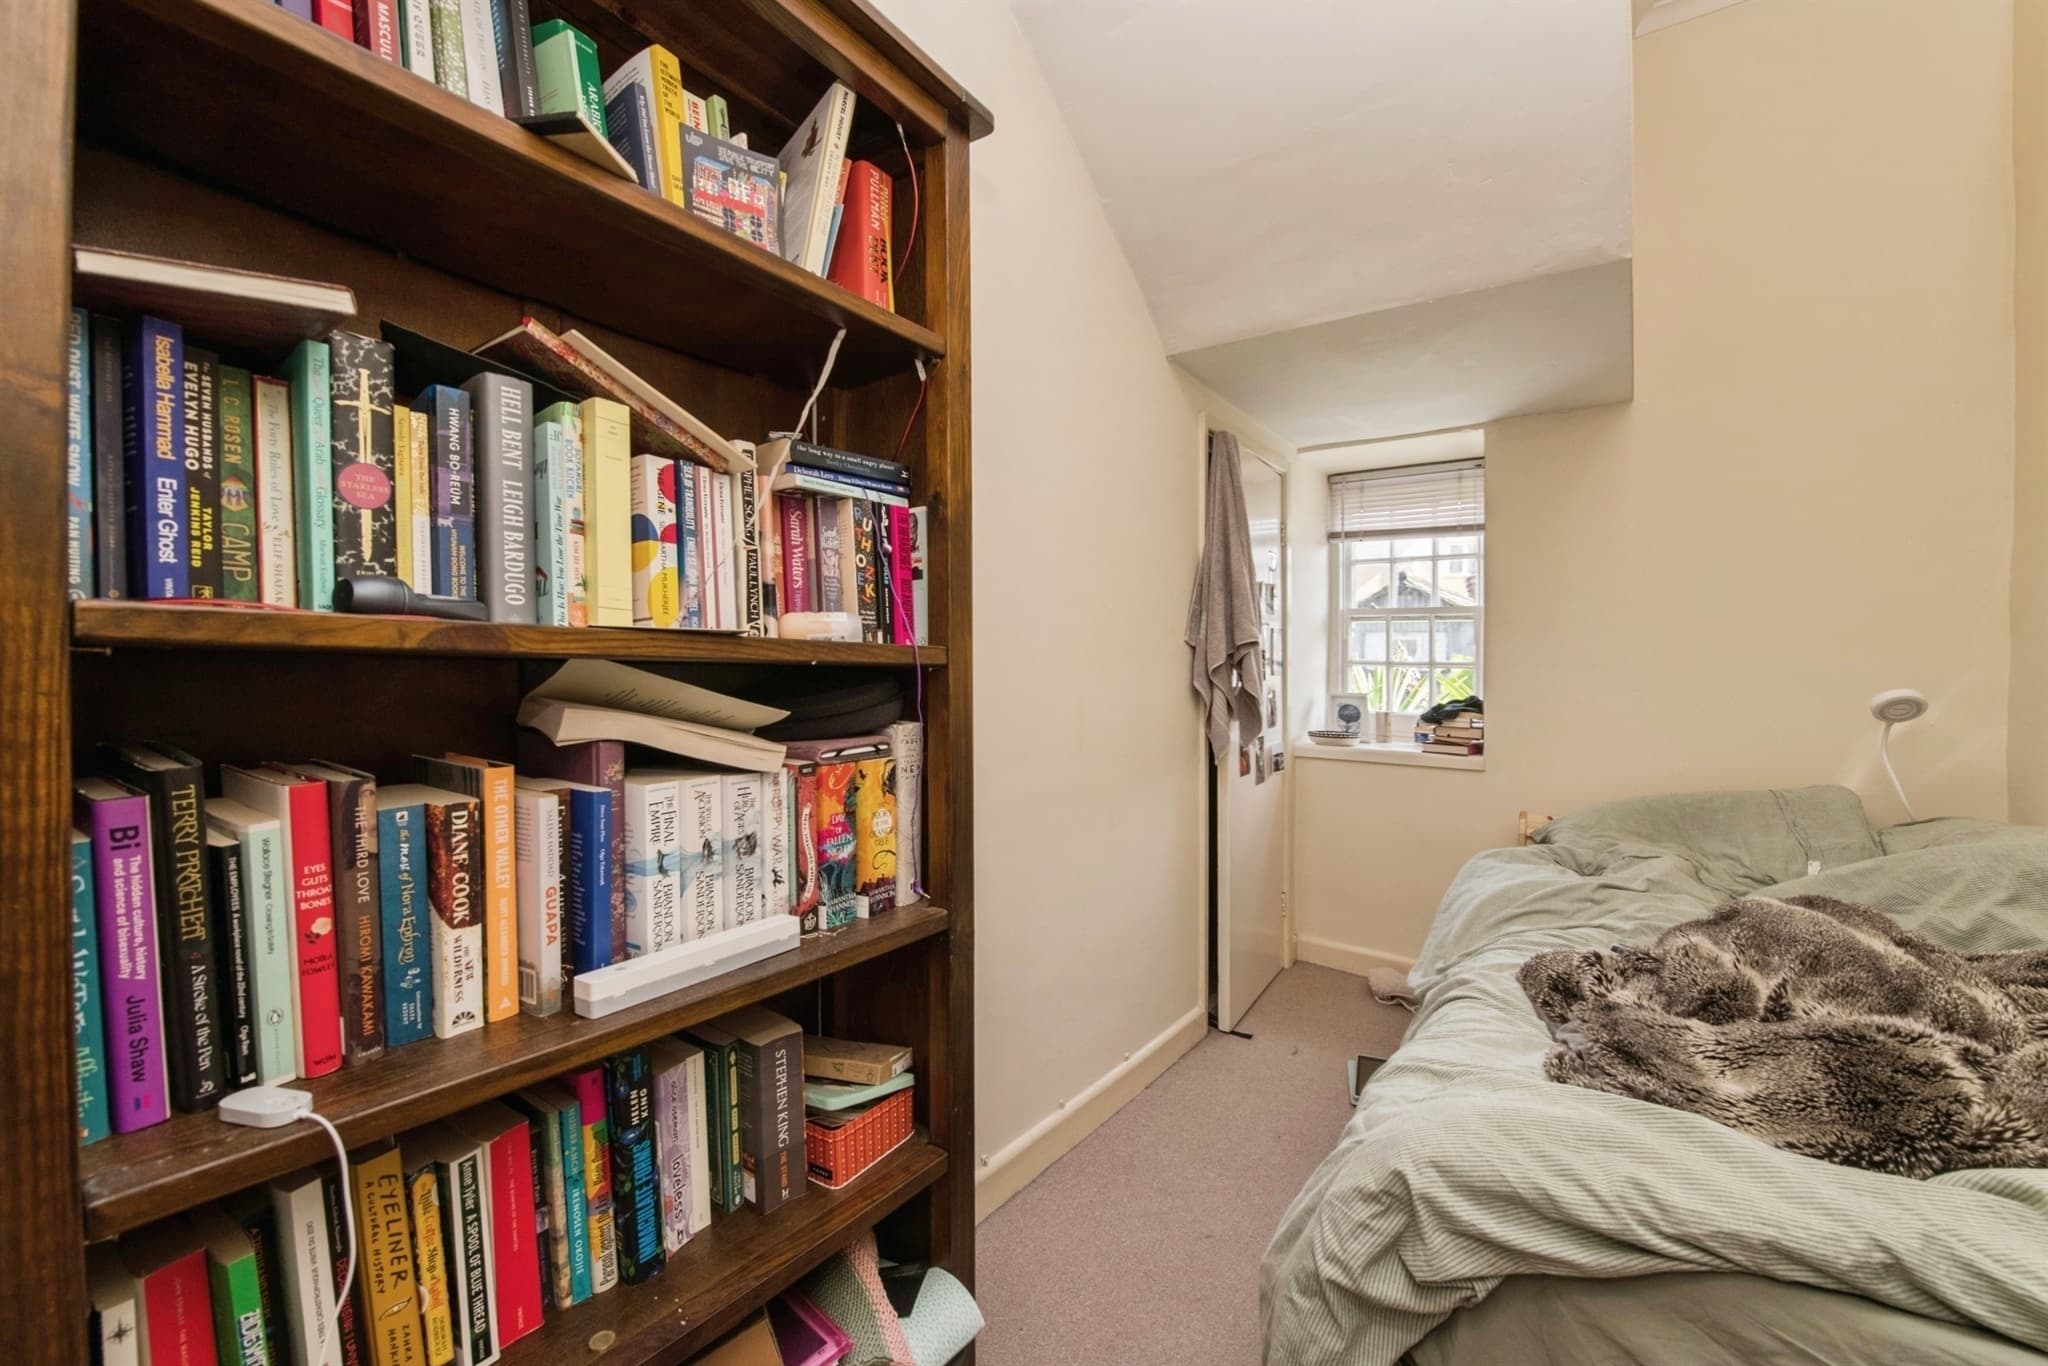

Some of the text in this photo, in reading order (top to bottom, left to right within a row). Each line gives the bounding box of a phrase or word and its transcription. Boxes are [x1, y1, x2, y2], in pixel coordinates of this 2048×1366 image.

[840, 90, 850, 115] MARCEL
[870, 169, 880, 230] PULLMAN
[880, 238, 888, 284] BOOK
[155, 335, 176, 461] Isabella Hammad
[183, 361, 200, 471] EVELYN HUGO
[267, 421, 281, 449] Forty
[312, 357, 328, 530] The Queer Arab Glossary
[500, 386, 523, 471] HELL BENT
[269, 450, 282, 479] Rules
[271, 481, 283, 492] of
[807, 446, 822, 456] long
[822, 450, 833, 459] way
[862, 458, 878, 469] angry
[878, 462, 895, 471] planet
[157, 477, 178, 563] Enter Ghost
[189, 487, 202, 568] JENKINS REID
[202, 507, 213, 550] TAYLOR
[271, 495, 284, 522] Love
[744, 504, 756, 537] SONG
[69, 516, 82, 584] PAN HUITING
[221, 522, 250, 582] CAMP
[272, 536, 285, 605] ELIF SHAFAK
[502, 479, 526, 606] LEIGH BARDUGO
[789, 511, 805, 589] Sarah Waters
[660, 572, 669, 616] MUKHERJEE
[749, 552, 760, 618] PAUL LYNCH
[647, 801, 664, 846] EMPIRE
[662, 795, 678, 846] THE FINAL
[693, 790, 707, 840] ASCENSION
[733, 801, 747, 836] OF AGES
[736, 786, 750, 813] HERO
[748, 797, 756, 808] THE
[108, 825, 141, 852] Bi
[354, 805, 370, 903] THE THIRD LOVE
[493, 777, 511, 889] THE OTHER VALLEY
[546, 809, 556, 878] SALEEM HADDAD
[705, 824, 712, 833] OF
[772, 834, 784, 865] WAR
[170, 784, 206, 942] TERRY PRATCHETT
[228, 856, 238, 871] THE
[228, 871, 240, 911] EMPLOYEES
[260, 838, 273, 901] Wallace Stegner
[301, 877, 329, 886] GUTS
[303, 865, 326, 875] EYES
[450, 810, 471, 926] DIANE COOK
[113, 858, 132, 980] and science of bisexuality
[128, 855, 147, 980] The hidden culture, history
[295, 889, 332, 900] THROAT
[299, 899, 332, 911] BONES
[396, 829, 421, 966] the most of Nora Ephron
[544, 885, 558, 947] GUAPA
[652, 879, 664, 953] SANDERSON
[662, 883, 674, 943] BRANDON
[695, 871, 706, 939] SANDERSON
[705, 874, 715, 930] BRANDON
[735, 863, 745, 927] SANDERSON
[744, 867, 755, 922] BRANDON
[230, 919, 243, 948] workplace
[232, 949, 244, 965] novel
[233, 965, 244, 973] of
[234, 973, 245, 982] the
[359, 915, 375, 1036] HIROMI KAWAKAMI
[452, 934, 465, 1004] WILDERNESS
[464, 960, 474, 982] NEW
[190, 964, 213, 1071] A Stroke of the Pen
[234, 997, 247, 1019] century
[125, 995, 153, 1083] Julia Shaw
[629, 1089, 640, 1125] HELEN
[639, 1087, 648, 1118] KING
[670, 1081, 680, 1144] alice oseman
[774, 1048, 789, 1148] STEPHEN KING
[568, 1108, 579, 1175] NUDIBRANCH
[461, 1161, 475, 1210] Anne Tyler
[631, 1139, 658, 1263] IMMACULATE FORMS
[671, 1153, 686, 1221] loveless
[780, 1166, 789, 1188] STAND
[367, 1193, 379, 1244] CULTURAL
[381, 1174, 408, 1288] EYELINER
[571, 1188, 585, 1275] IRENOSEN OKOJIE
[372, 1249, 385, 1295] HISTORY
[466, 1214, 486, 1333] A SPOOL OF BLUE THREAD
[402, 1324, 411, 1362] ZAHRA
